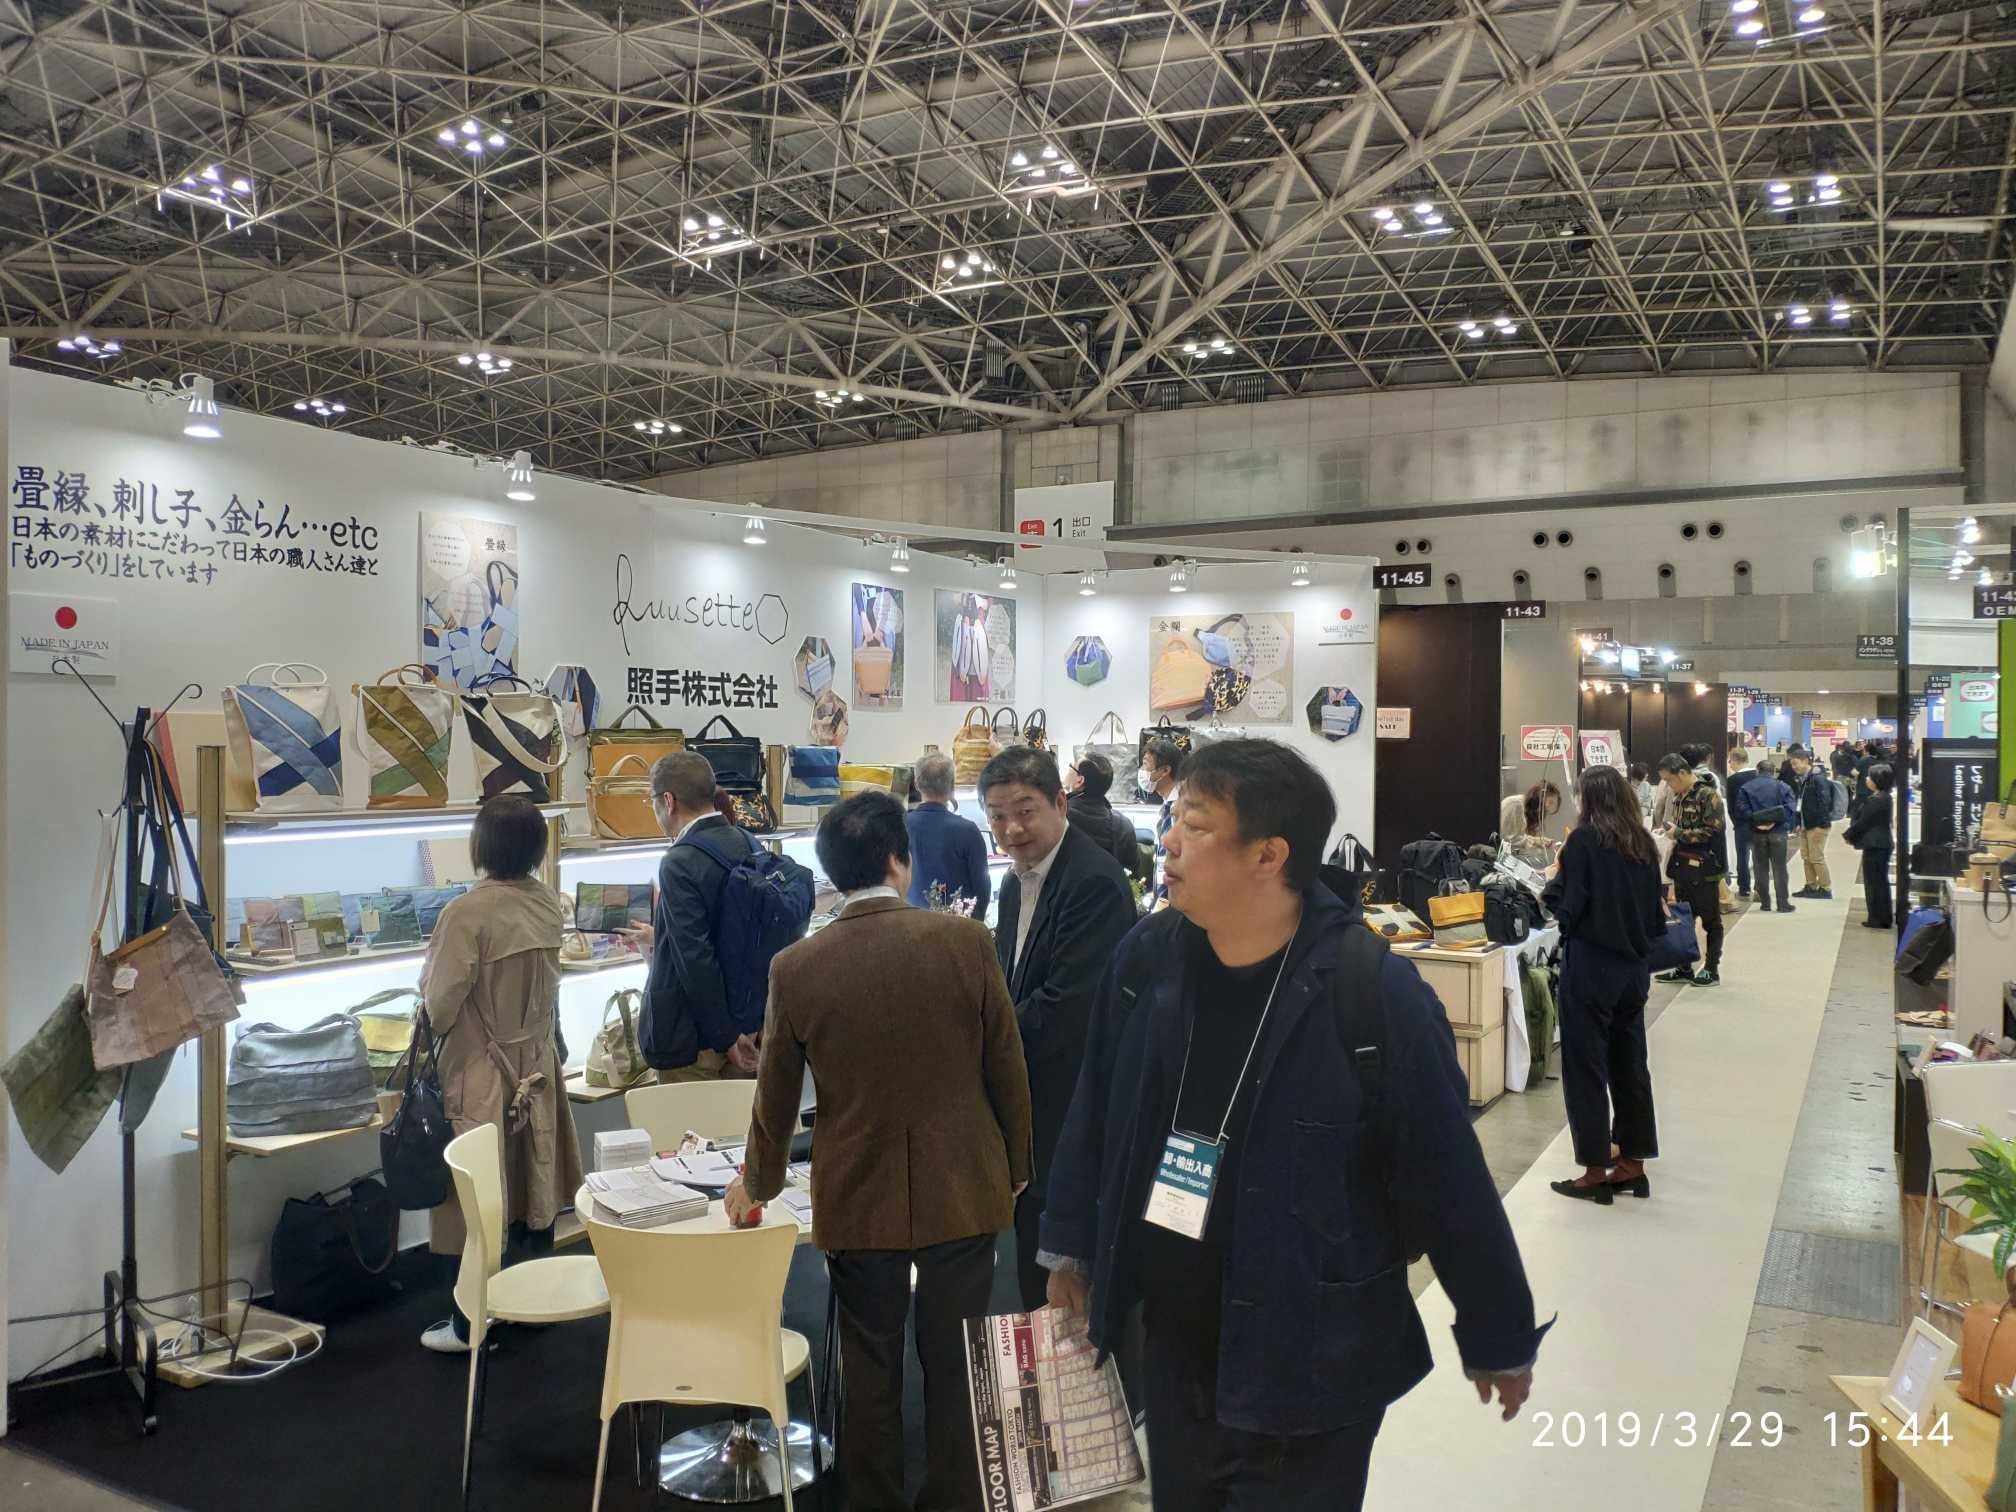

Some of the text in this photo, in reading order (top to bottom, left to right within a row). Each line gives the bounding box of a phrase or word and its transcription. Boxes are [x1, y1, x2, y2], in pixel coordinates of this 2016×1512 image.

[1053, 517, 1063, 538] 1
[1072, 516, 1091, 528] 出口
[1072, 529, 1086, 538] Exit
[12, 516, 379, 576] 日本の素材にこだわって日本の職人さん達と
[11, 542, 218, 586] 「ものづくり」をしています
[1380, 572, 1424, 586] 11-45
[1981, 591, 2016, 602] 11-4
[1505, 606, 1541, 617] 11-43
[20, 636, 110, 650] MADE IN JAPAN
[1862, 636, 1894, 646] 11-38
[627, 667, 779, 709] 照手株式会社
[1953, 765, 1966, 799] Leather
[983, 1426, 1001, 1459] MAP
[1011, 1461, 1024, 1495] FASHION
